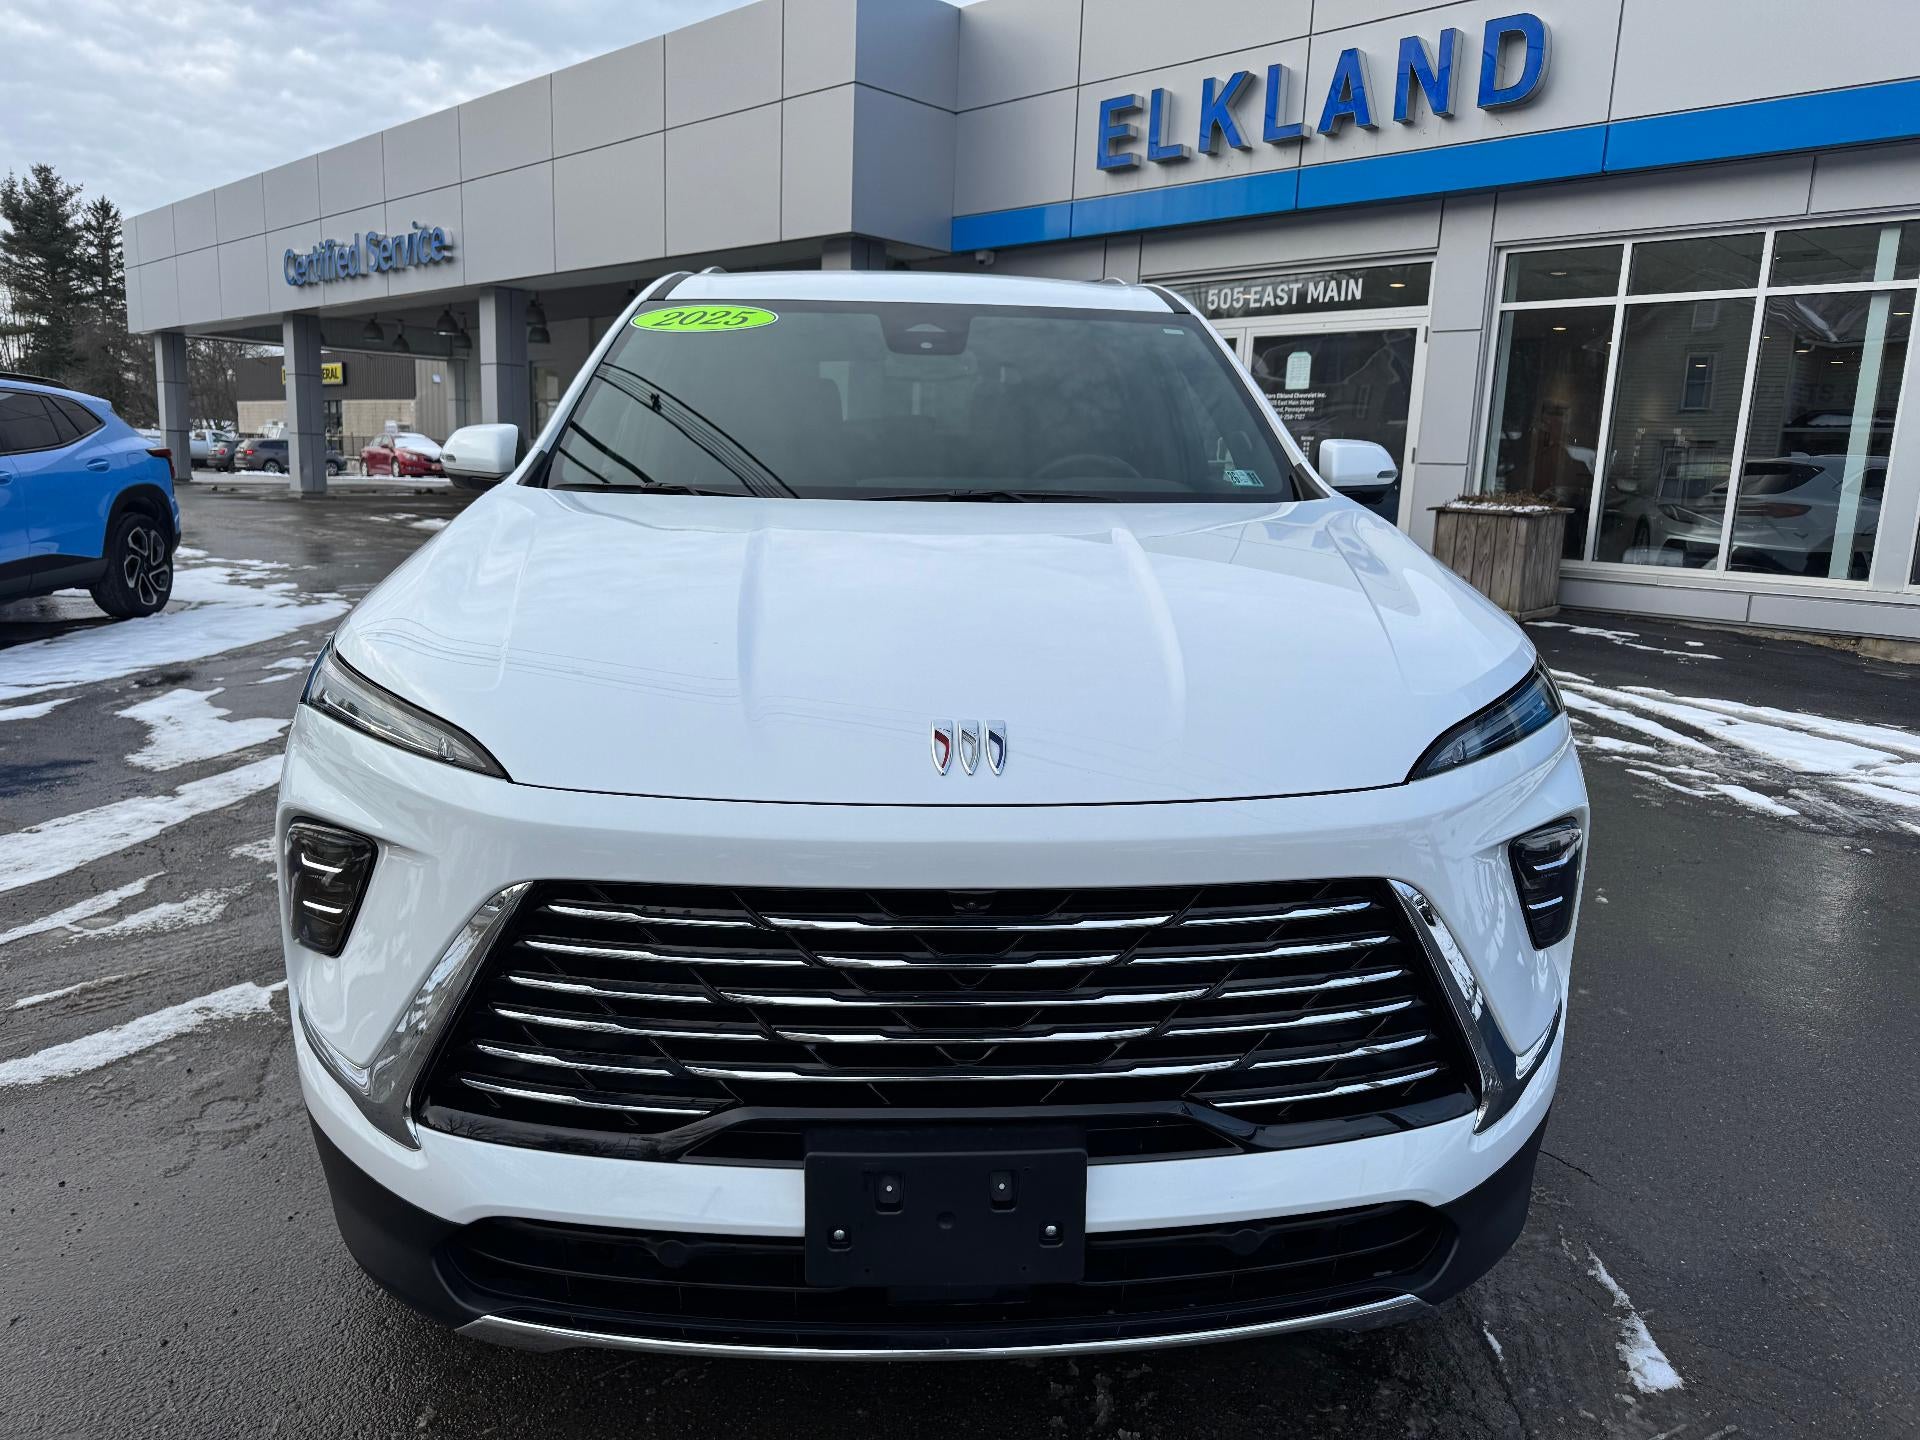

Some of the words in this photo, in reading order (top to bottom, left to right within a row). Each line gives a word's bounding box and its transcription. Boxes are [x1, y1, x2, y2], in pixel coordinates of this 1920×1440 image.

[1096, 12, 1550, 171] ELKLAND
[284, 233, 362, 286] Certified
[366, 221, 447, 273] Service
[1207, 287, 1244, 310] 505
[1249, 283, 1303, 308] EAST
[1307, 278, 1364, 304] MAIN
[651, 310, 758, 327] 2025
[321, 367, 339, 380] ERAL
[1294, 391, 1317, 399] Chevrolet
